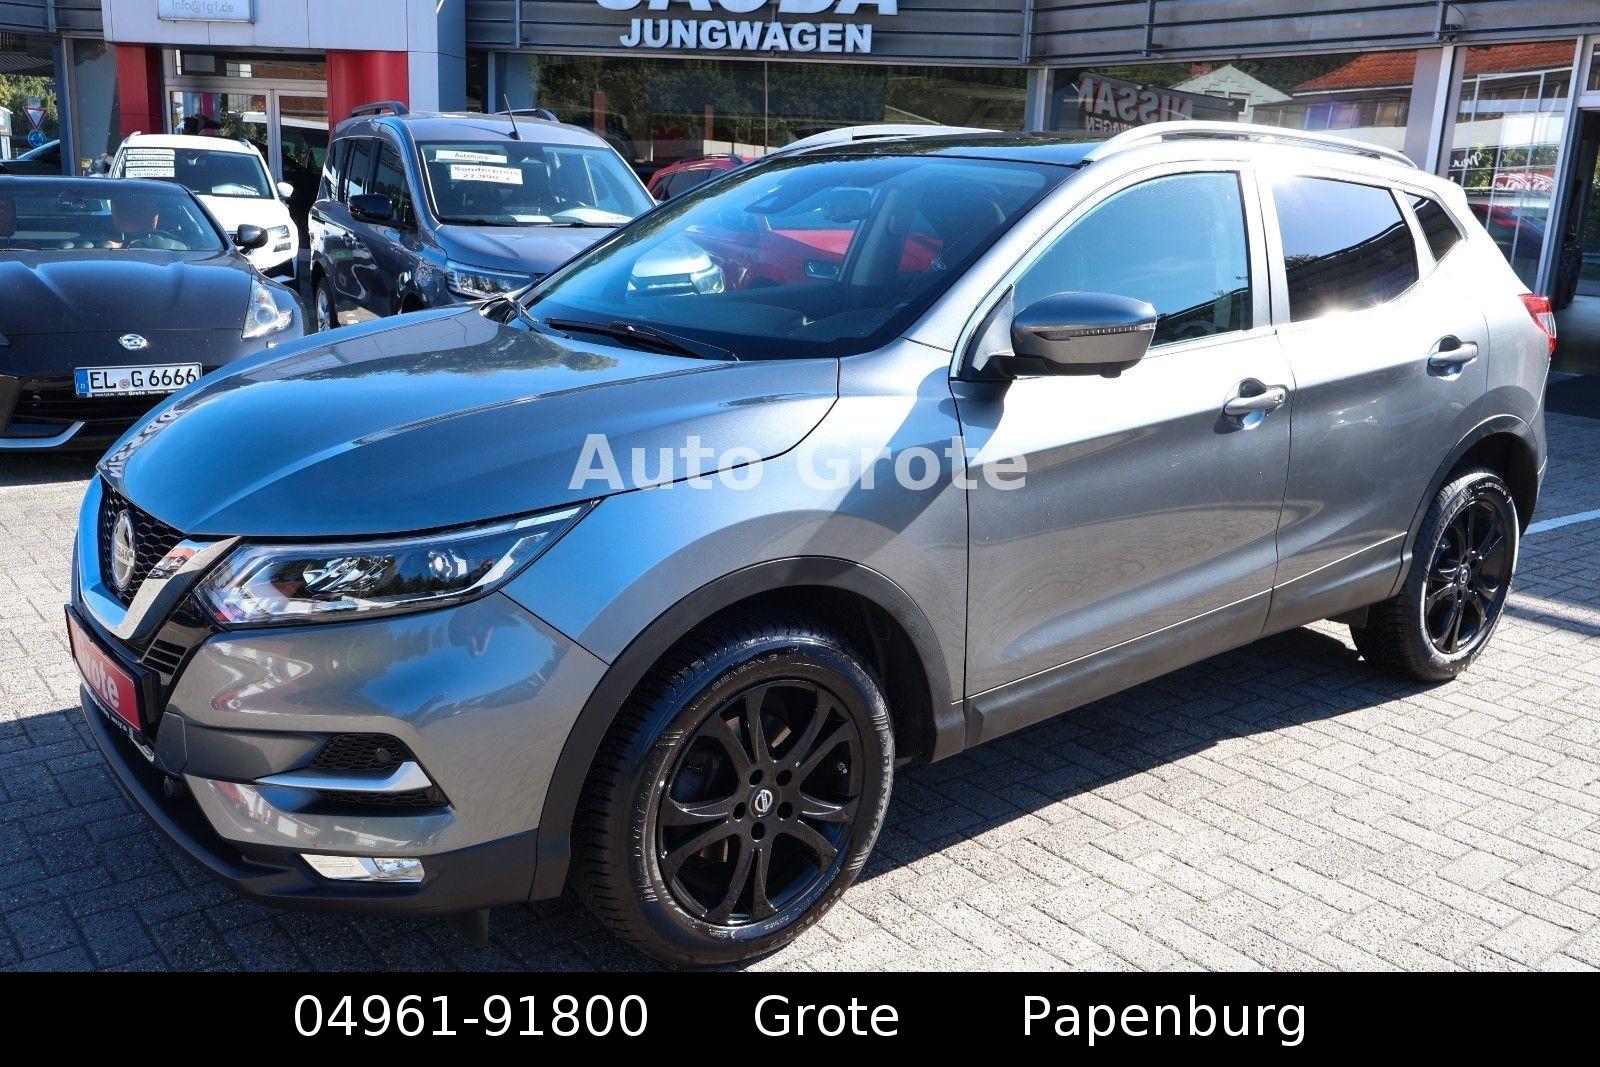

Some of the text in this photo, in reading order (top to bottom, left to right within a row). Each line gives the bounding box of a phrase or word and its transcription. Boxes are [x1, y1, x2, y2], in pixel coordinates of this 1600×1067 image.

[619, 18, 873, 54] JUNGWAGEN
[89, 368, 197, 390] EL G 6666
